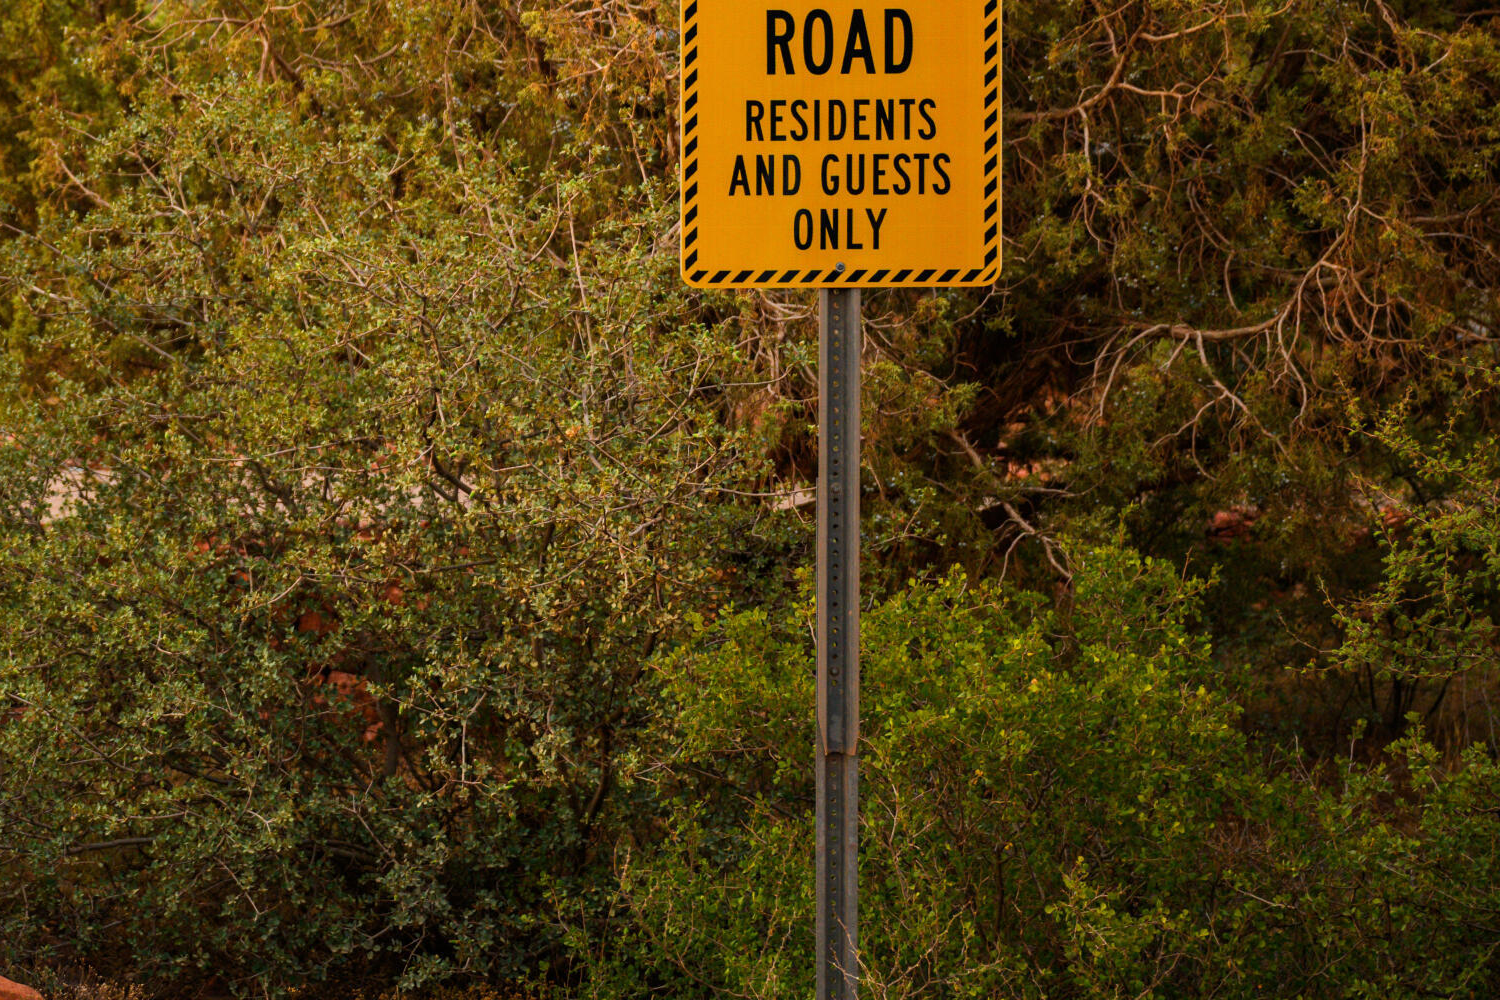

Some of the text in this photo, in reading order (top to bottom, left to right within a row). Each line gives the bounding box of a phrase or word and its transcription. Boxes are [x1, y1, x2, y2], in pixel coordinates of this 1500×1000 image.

[766, 8, 913, 75] ROAD
[746, 98, 937, 142] RESIDENTS
[728, 153, 951, 197] AND GUESTS
[793, 208, 888, 250] ONLY
